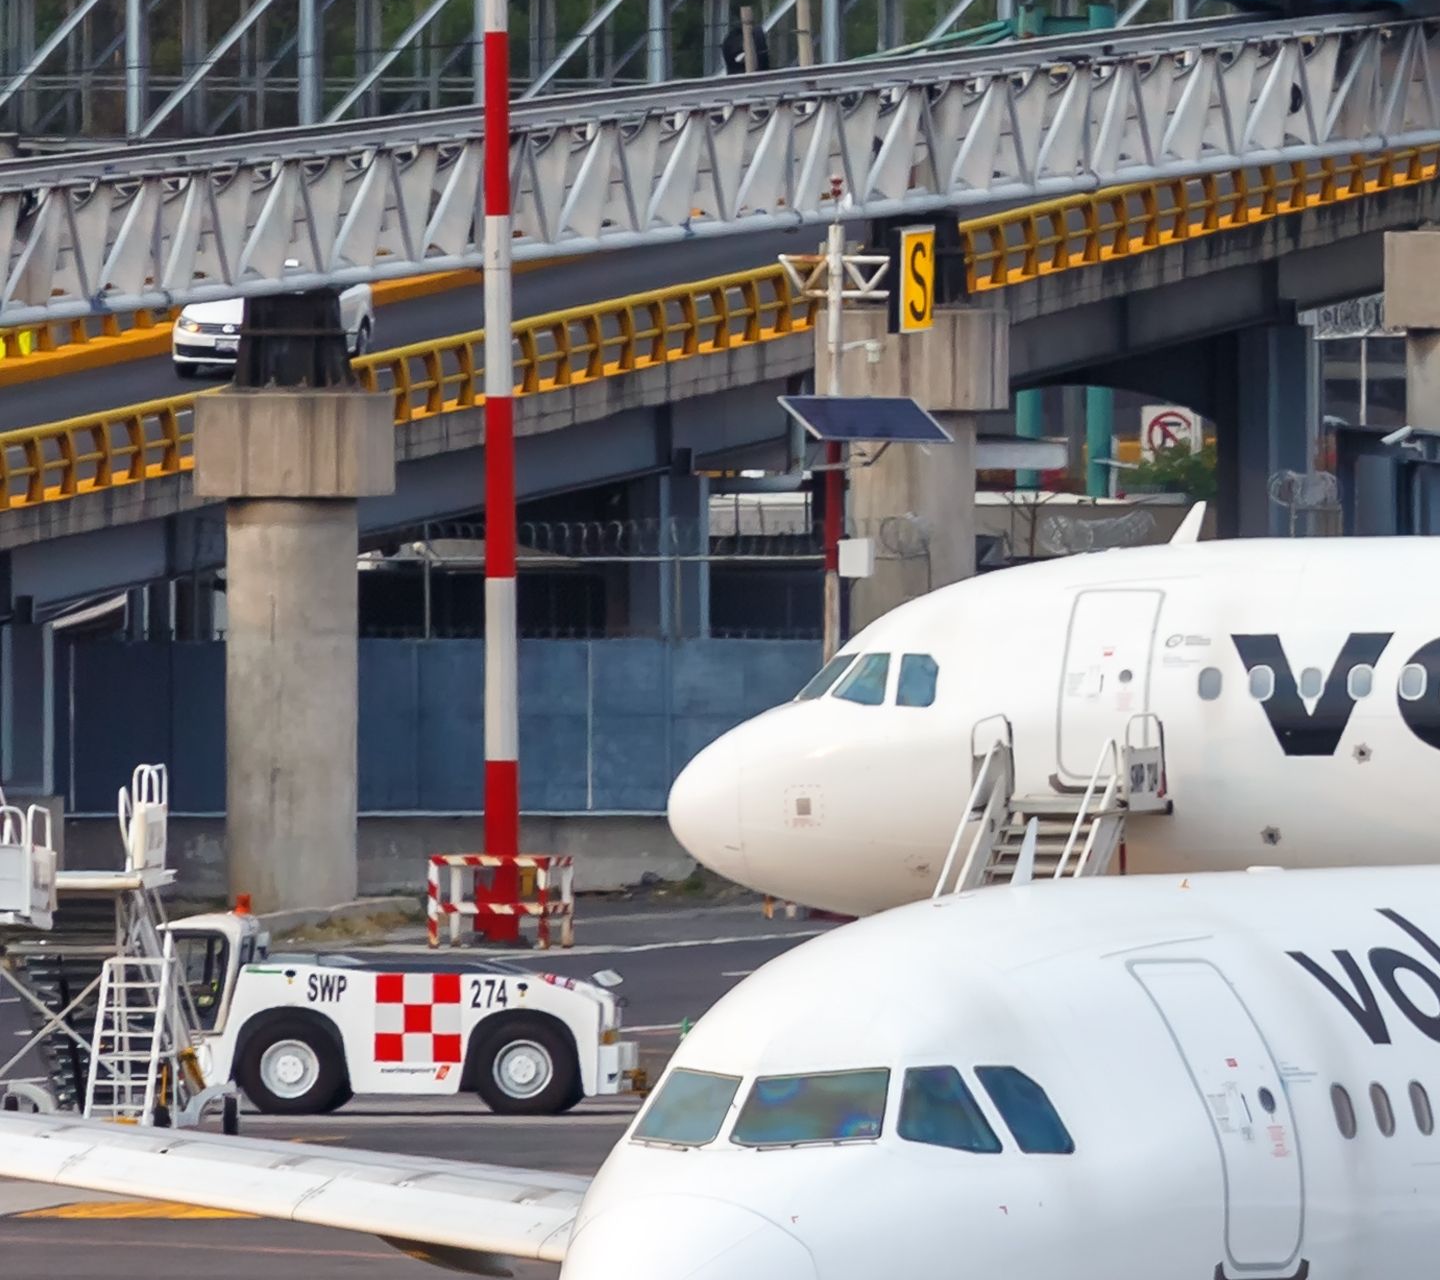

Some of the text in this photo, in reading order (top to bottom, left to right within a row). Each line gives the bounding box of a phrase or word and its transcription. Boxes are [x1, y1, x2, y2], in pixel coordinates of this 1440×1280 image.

[909, 241, 928, 322] S
[307, 973, 508, 1009] SWP 274
